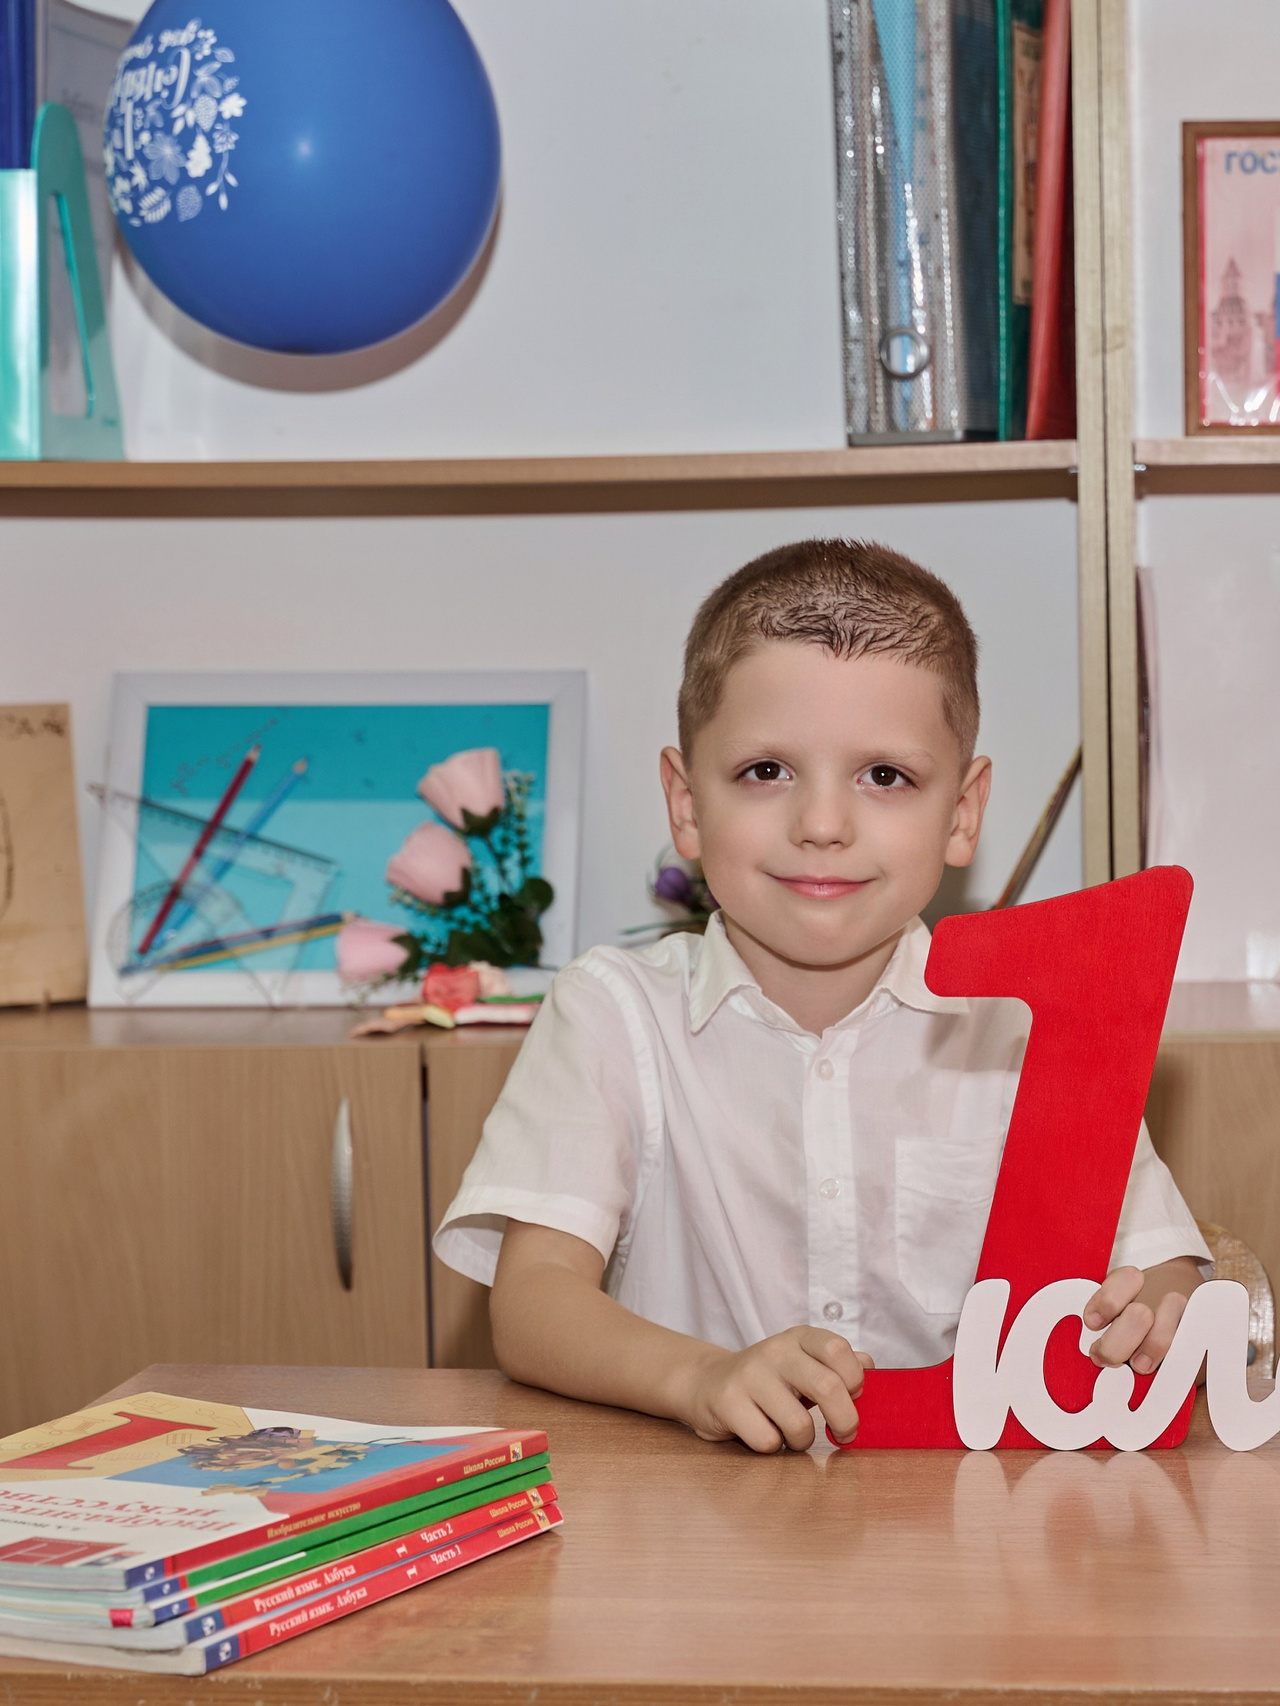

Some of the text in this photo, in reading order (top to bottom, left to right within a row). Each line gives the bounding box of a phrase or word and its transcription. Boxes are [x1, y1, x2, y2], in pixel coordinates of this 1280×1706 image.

[826, 865, 1195, 1450] 1
[253, 1586, 294, 1613] Русский
[294, 1578, 322, 1597] язык.
[323, 1564, 356, 1585] Азбука
[420, 1527, 447, 1543] Часть
[445, 1522, 454, 1535] 2
[489, 1506, 508, 1518] Школа
[507, 1498, 528, 1511] России
[267, 1513, 326, 1539] Изобразительное
[327, 1502, 361, 1520] искусство
[463, 1461, 484, 1475] Школа
[484, 1455, 506, 1468] России
[269, 1610, 308, 1637] Русский
[308, 1601, 335, 1619] язык.
[336, 1586, 368, 1608] Азбука
[429, 1549, 456, 1565] Часть
[455, 1544, 462, 1556] 1
[497, 1526, 516, 1538] Школа
[515, 1518, 534, 1531] России
